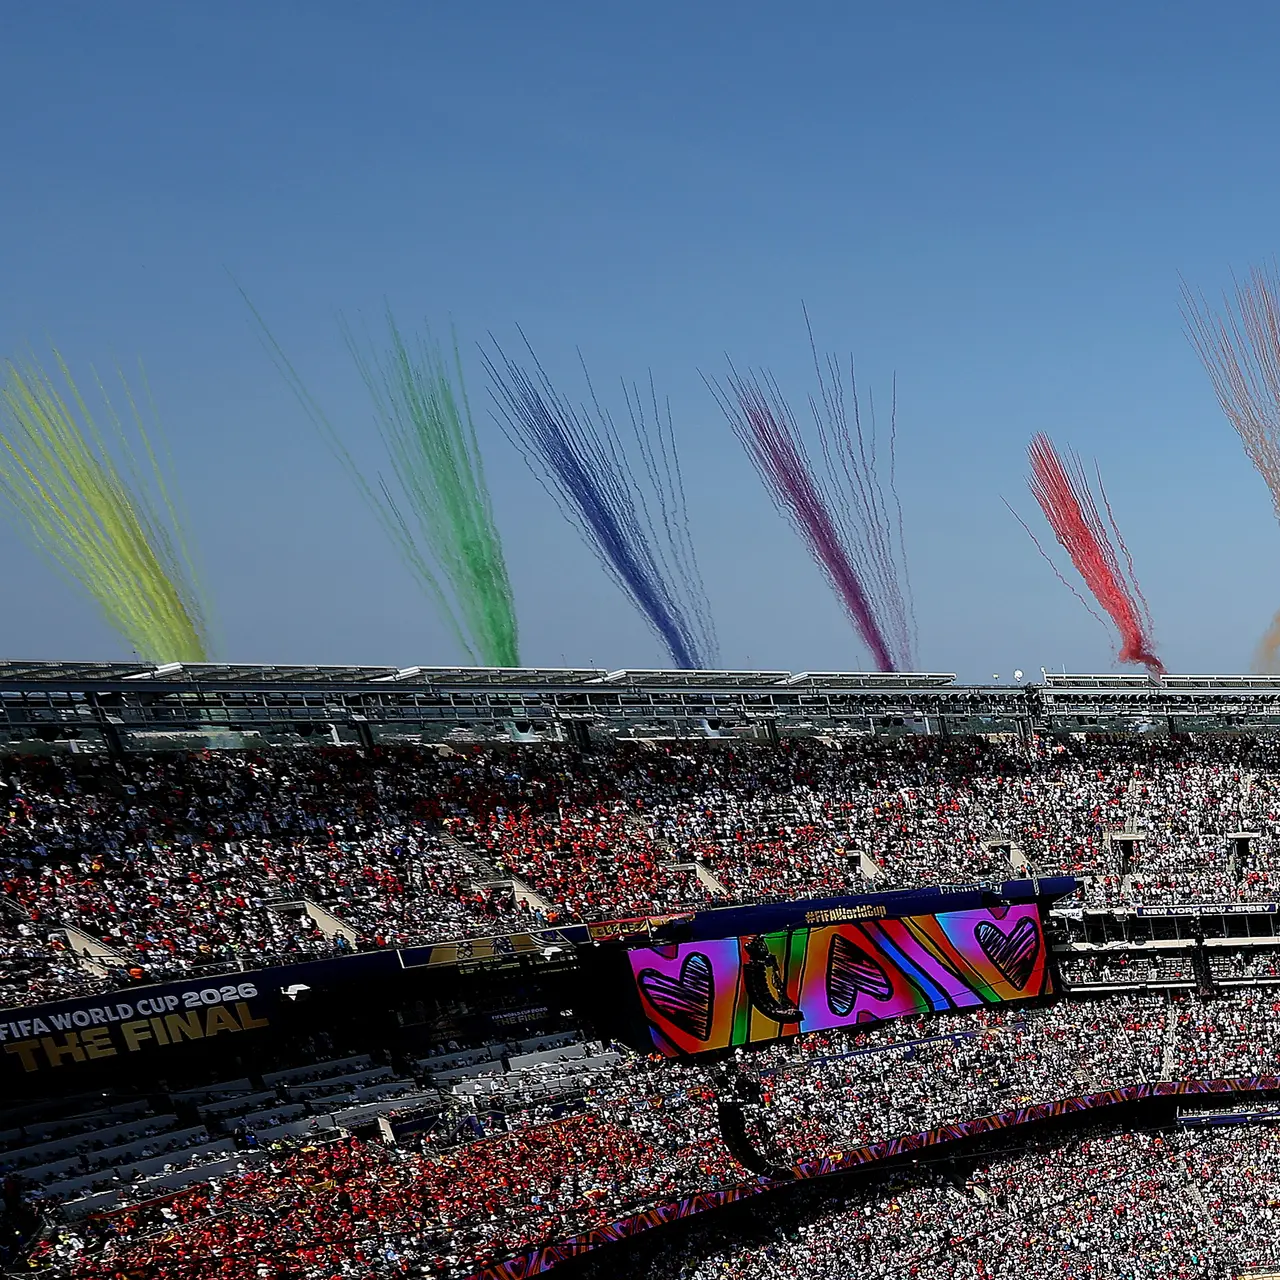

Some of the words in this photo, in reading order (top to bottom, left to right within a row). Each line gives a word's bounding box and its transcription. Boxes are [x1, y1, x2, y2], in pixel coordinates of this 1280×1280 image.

[805, 904, 887, 924] #FIFAWorldCup
[1142, 907, 1168, 915] NEW
[1202, 906, 1226, 914] NEW
[1227, 904, 1270, 913] JERSEY
[0, 1017, 49, 1041] FIFA
[49, 1003, 134, 1031] WORLD
[136, 995, 180, 1016] CUP
[182, 983, 258, 1008] 2026
[493, 1017, 518, 1027] THE
[4, 1027, 118, 1073] THE
[121, 1002, 270, 1051] FINAL
